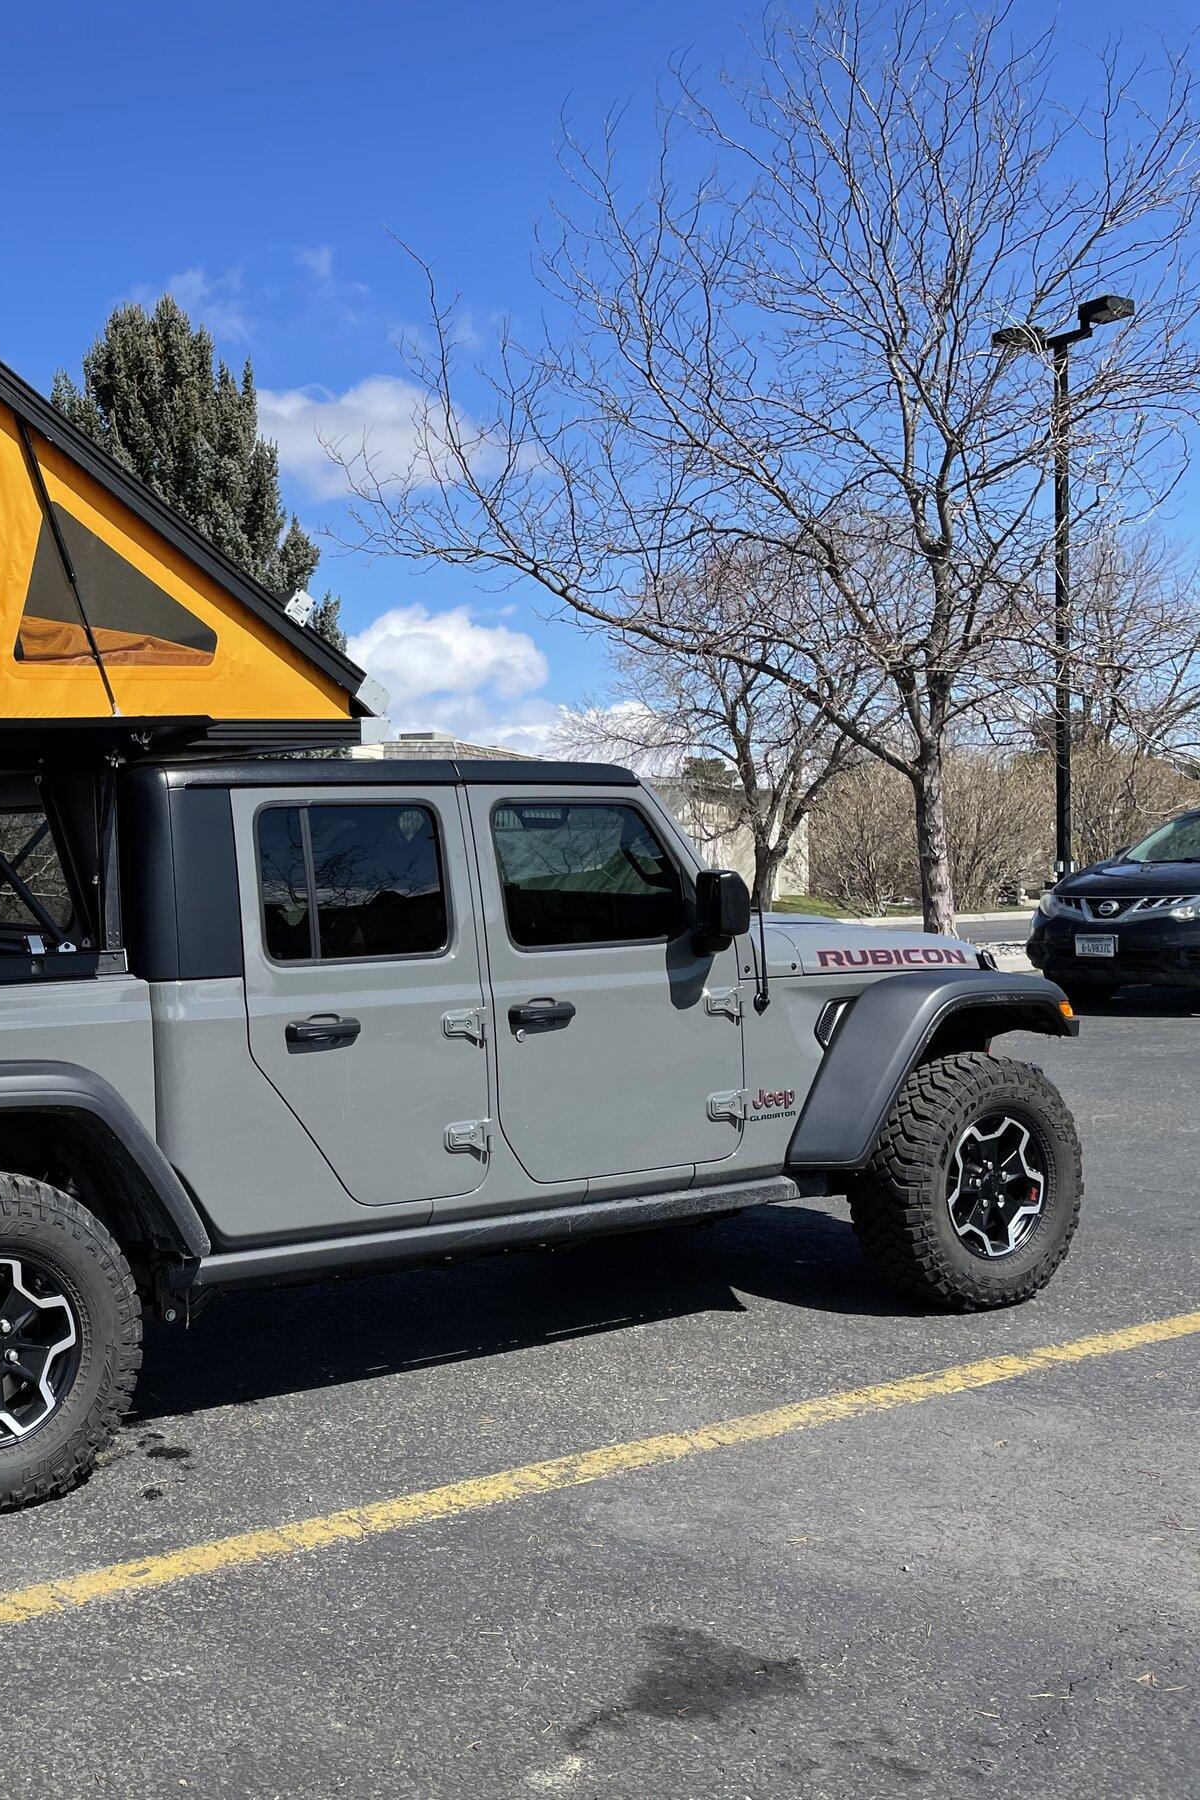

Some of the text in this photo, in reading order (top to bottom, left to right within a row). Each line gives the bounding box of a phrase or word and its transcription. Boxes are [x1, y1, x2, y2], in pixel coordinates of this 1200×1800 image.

[816, 949, 967, 967] RUBICON
[752, 1089, 795, 1110] Jeep
[750, 1110, 796, 1122] GLADIATOR
